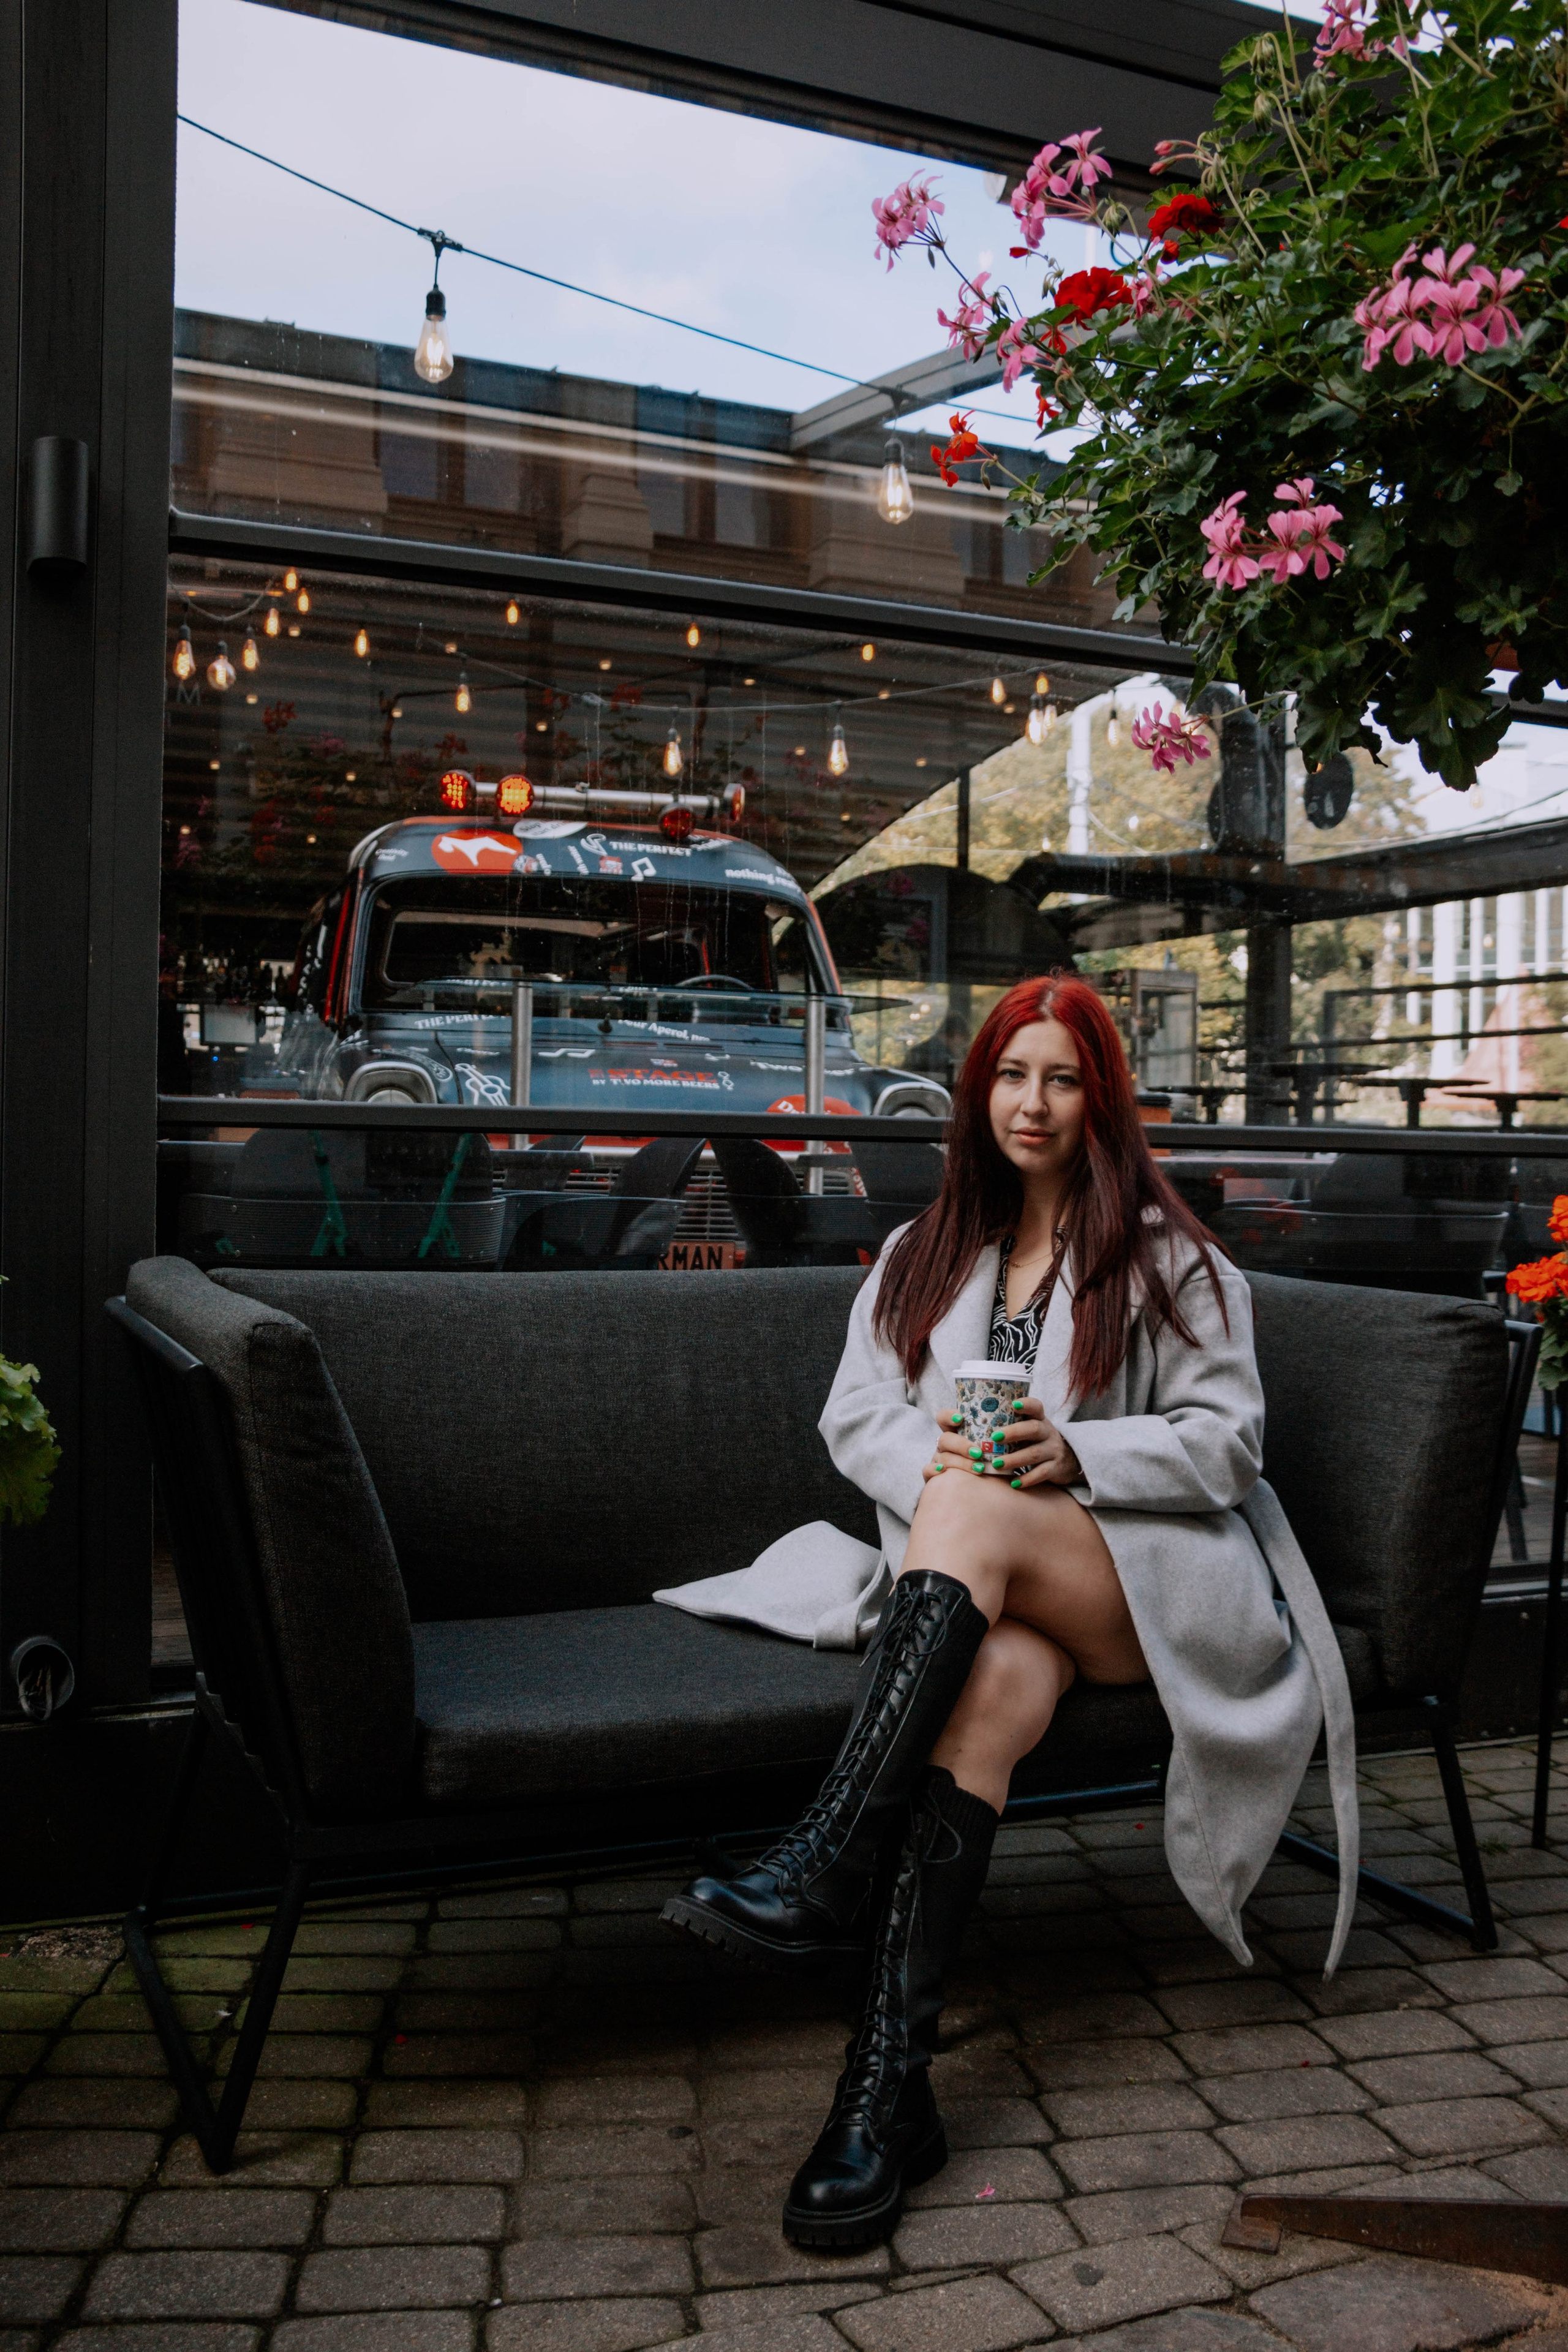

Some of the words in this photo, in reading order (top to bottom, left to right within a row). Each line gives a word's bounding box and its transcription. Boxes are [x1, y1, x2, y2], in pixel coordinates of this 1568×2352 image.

[609, 841, 636, 852] THE
[637, 843, 692, 857] PERFECT
[415, 1016, 445, 1030] THE
[647, 1022, 690, 1041] Aperol,
[607, 1069, 718, 1084] STAGE
[682, 1081, 720, 1090] BEERS
